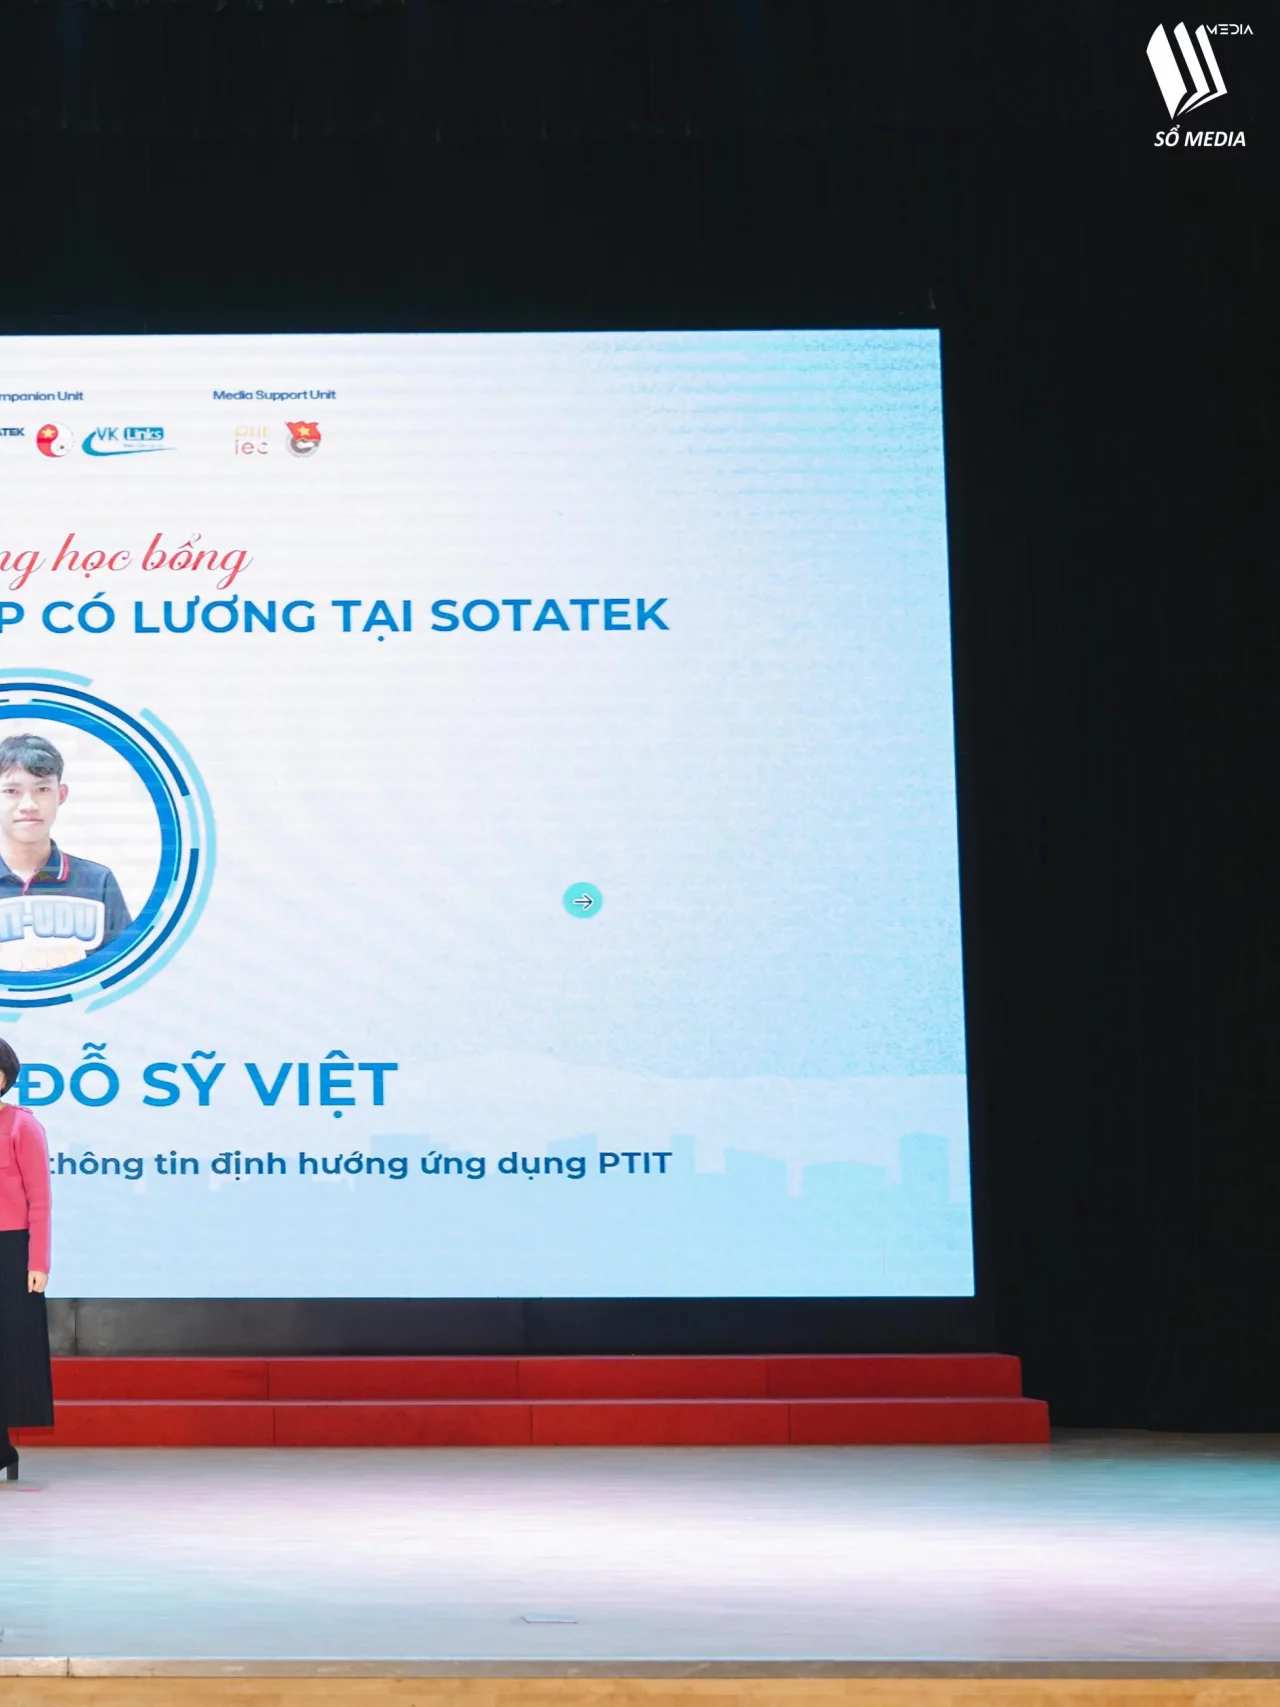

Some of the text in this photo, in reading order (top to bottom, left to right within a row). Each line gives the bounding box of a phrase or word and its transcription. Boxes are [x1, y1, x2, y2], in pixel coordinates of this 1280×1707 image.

[57, 391, 84, 401] Unit
[213, 390, 336, 401] Media Support Unit
[96, 427, 162, 441] VK Links
[51, 533, 132, 579] học
[140, 532, 255, 590] bổng
[41, 592, 115, 634] CÓ
[134, 594, 316, 633] LƯƠNG
[327, 600, 412, 642] TẠI
[430, 598, 670, 632] SOTATEK
[15, 1041, 120, 1107] ĐỖ
[142, 1050, 226, 1106] SỸ
[244, 1049, 398, 1119] VIỆT
[154, 1150, 200, 1175] tin
[211, 1150, 287, 1181] định
[299, 1151, 408, 1180] hướng
[420, 1151, 486, 1180] ứng
[497, 1152, 586, 1181] dụng
[599, 1152, 673, 1174] PTIT
